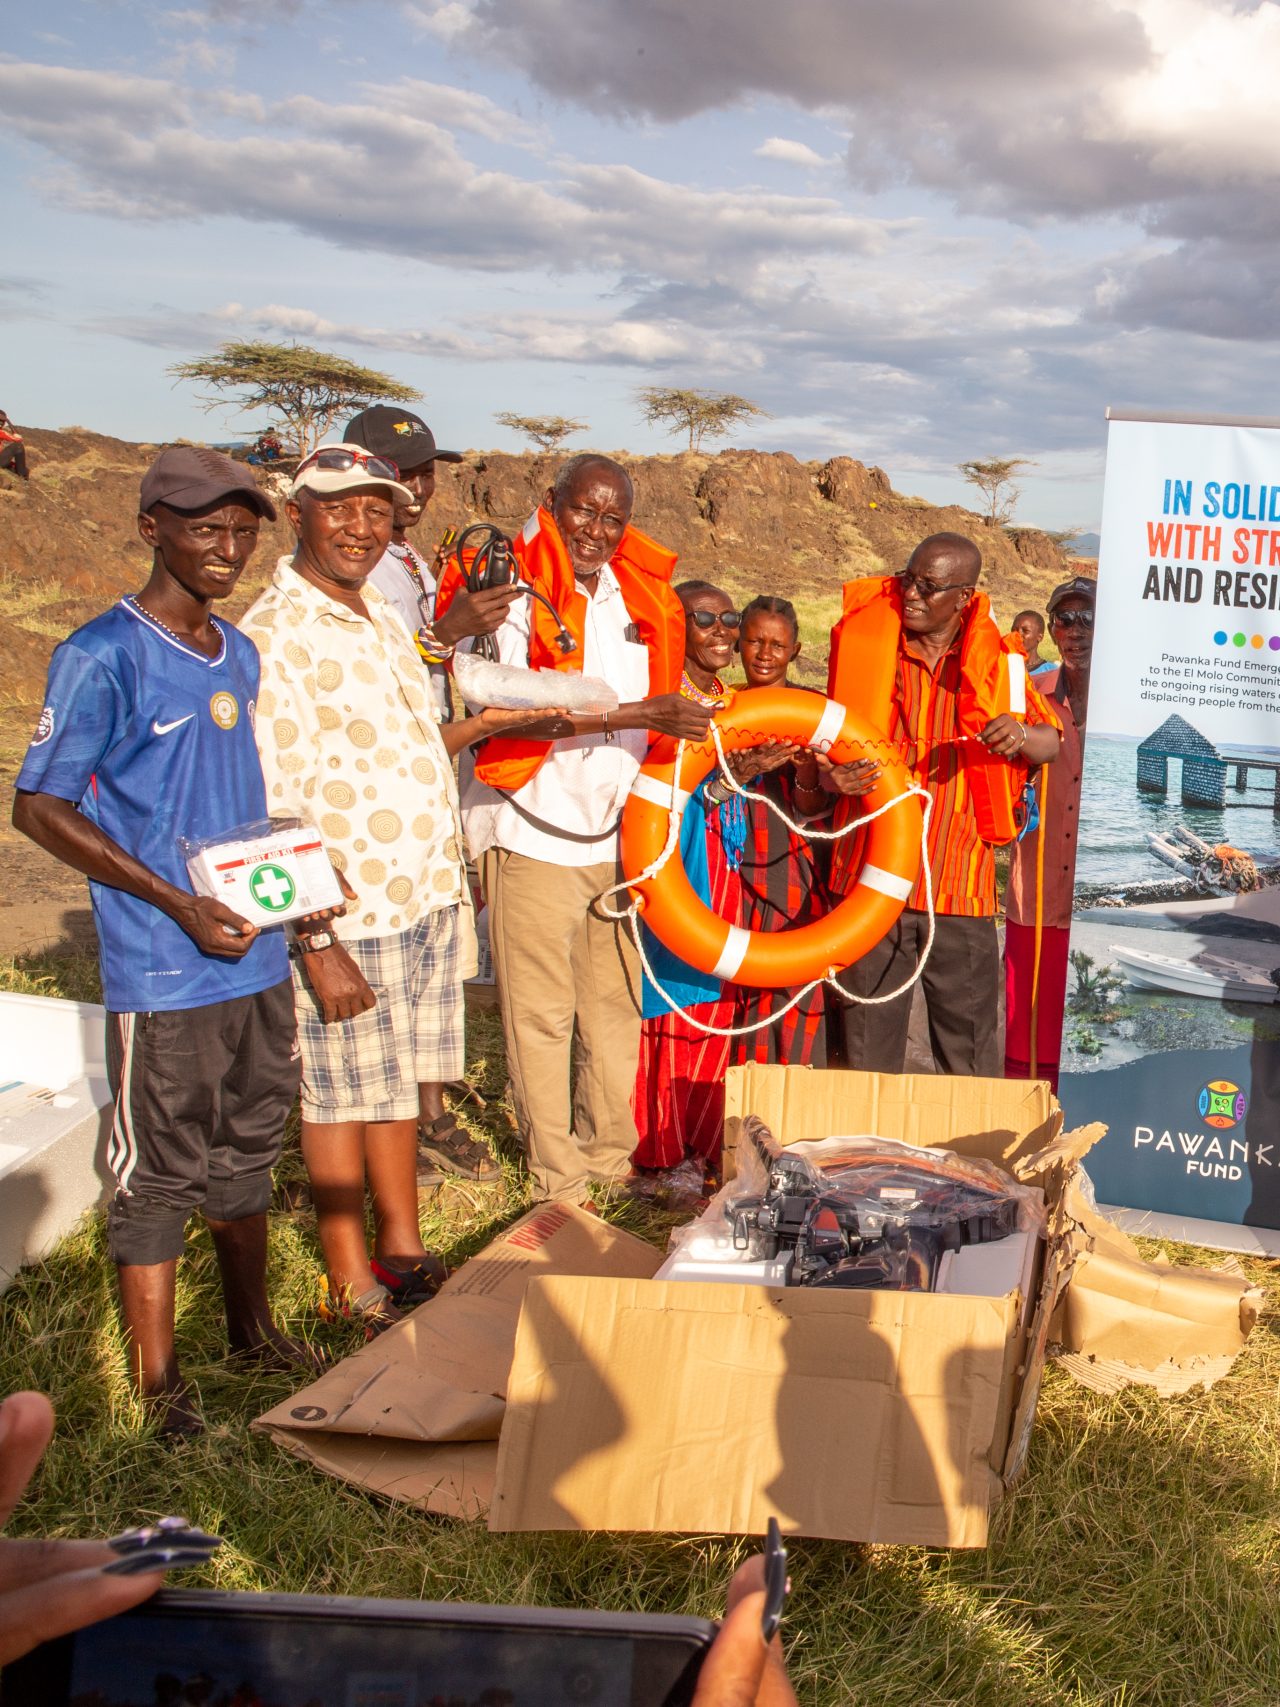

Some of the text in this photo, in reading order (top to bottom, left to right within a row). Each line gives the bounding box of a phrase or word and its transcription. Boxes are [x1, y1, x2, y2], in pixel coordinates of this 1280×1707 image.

[1163, 479, 1192, 516] IN
[1147, 521, 1222, 562] WITH
[1142, 564, 1203, 604] AND
[1161, 653, 1211, 666] Pawanka
[1214, 657, 1241, 669] Fund
[1149, 666, 1160, 675] to
[1163, 666, 1181, 676] the
[1184, 668, 1194, 678] El
[1197, 670, 1223, 680] Molo
[1140, 678, 1158, 687] the
[1161, 681, 1206, 694] ongoing
[1209, 684, 1239, 697] rising
[1242, 688, 1276, 699] waters
[1140, 691, 1196, 706] displacing
[1199, 697, 1236, 708] people
[1238, 700, 1263, 711] from
[244, 853, 265, 865] FIRST
[268, 850, 281, 860] AID
[282, 847, 294, 857] KIT
[1186, 1160, 1242, 1181] FUND
